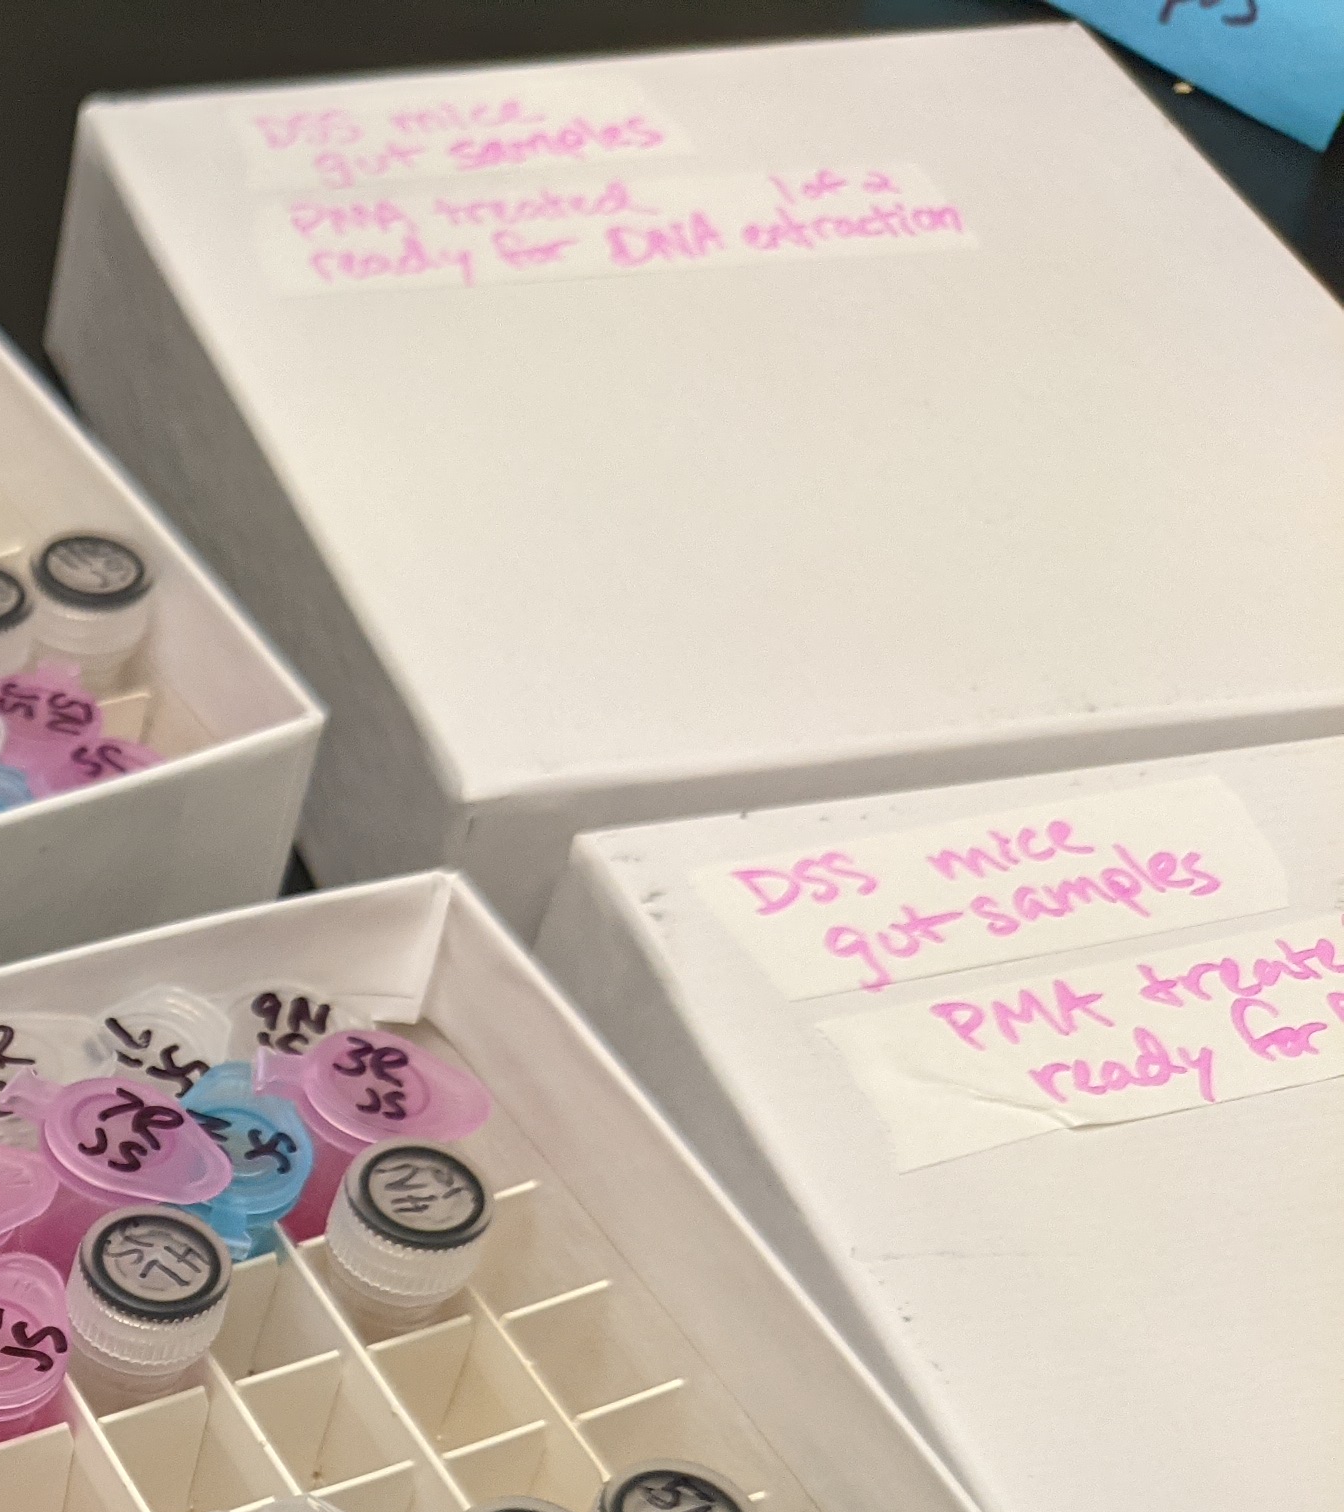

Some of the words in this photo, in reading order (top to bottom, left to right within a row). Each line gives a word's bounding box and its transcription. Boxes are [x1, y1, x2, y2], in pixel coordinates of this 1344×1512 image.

[450, 115, 665, 171] samples
[311, 236, 475, 286] ready
[606, 211, 725, 267] DNA
[742, 204, 965, 250] extraction
[731, 851, 879, 915] DSS
[926, 819, 1095, 881] mice
[823, 903, 964, 992] gut
[969, 843, 1222, 937] samples
[1136, 911, 1344, 1007] treate
[252, 990, 334, 1036] 9N
[1028, 1026, 1216, 1103] ready
[1230, 996, 1328, 1060] for
